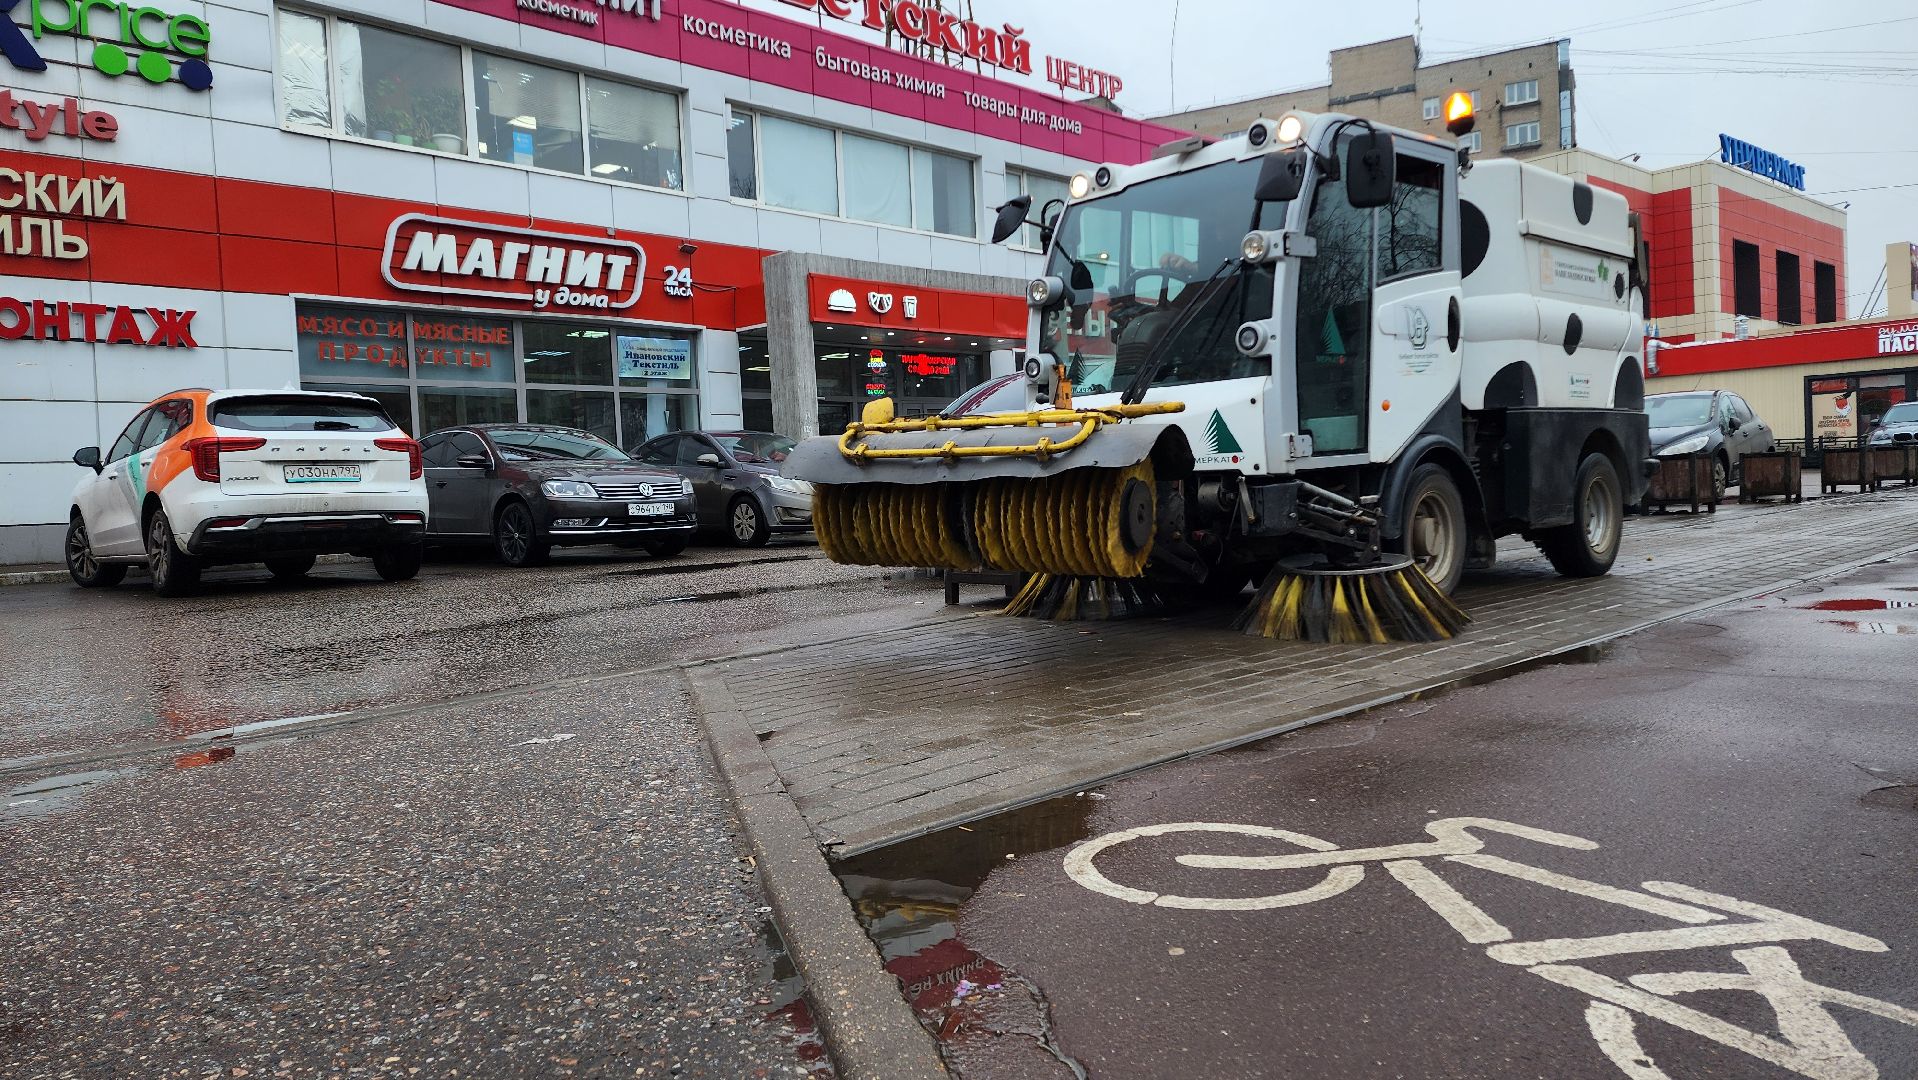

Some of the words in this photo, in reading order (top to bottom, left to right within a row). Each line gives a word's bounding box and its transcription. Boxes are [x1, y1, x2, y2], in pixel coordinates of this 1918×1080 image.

[31, 0, 211, 56] price
[683, 14, 792, 59] косметика
[815, 46, 891, 84] бытовая
[896, 72, 945, 99] химия
[963, 90, 1018, 118] товары
[1021, 107, 1046, 125] для
[1049, 115, 1082, 134] дома
[1045, 54, 1123, 100] ЦЕНТР
[1719, 133, 1806, 191] УНИВЕРМАГ
[400, 230, 633, 291] МАГНИТ
[664, 265, 693, 287] 24
[534, 288, 551, 308] у
[553, 286, 610, 308] дома
[664, 286, 694, 297] ЧАСА
[0, 297, 199, 348] ОНТАЖ
[297, 316, 378, 337] МЯСО
[387, 320, 405, 339] И
[413, 321, 509, 345] МЯСНЫЕ
[318, 341, 491, 368] ПРОДУКТЫ
[625, 351, 685, 362] Ивановский
[1878, 331, 1918, 354] ПАС
[632, 360, 680, 370] Текстиль
